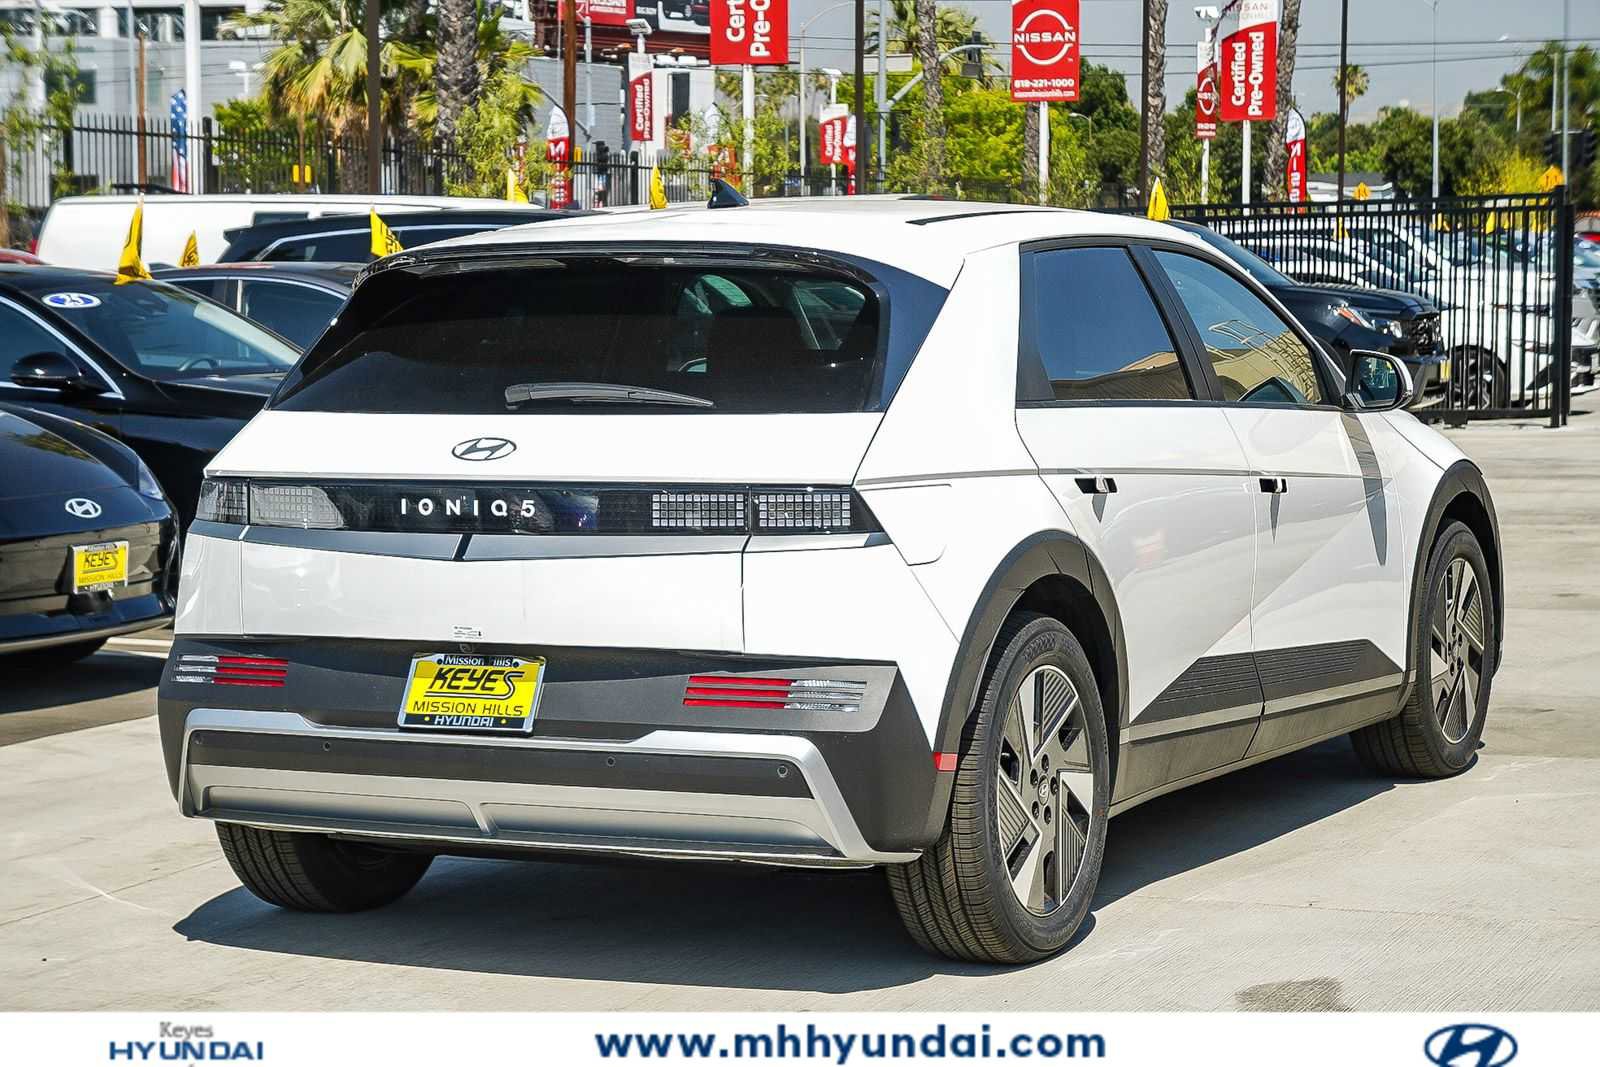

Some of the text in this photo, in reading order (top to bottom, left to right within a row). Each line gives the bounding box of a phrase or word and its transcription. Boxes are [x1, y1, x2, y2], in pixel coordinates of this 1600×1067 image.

[1013, 31, 1077, 43] NISSAN
[1231, 42, 1246, 106] Certified
[1247, 31, 1265, 116] Pre-Owned
[428, 667, 525, 697] KEYES
[412, 701, 523, 717] MISSION HILLS
[434, 715, 495, 727] HYUNDAI
